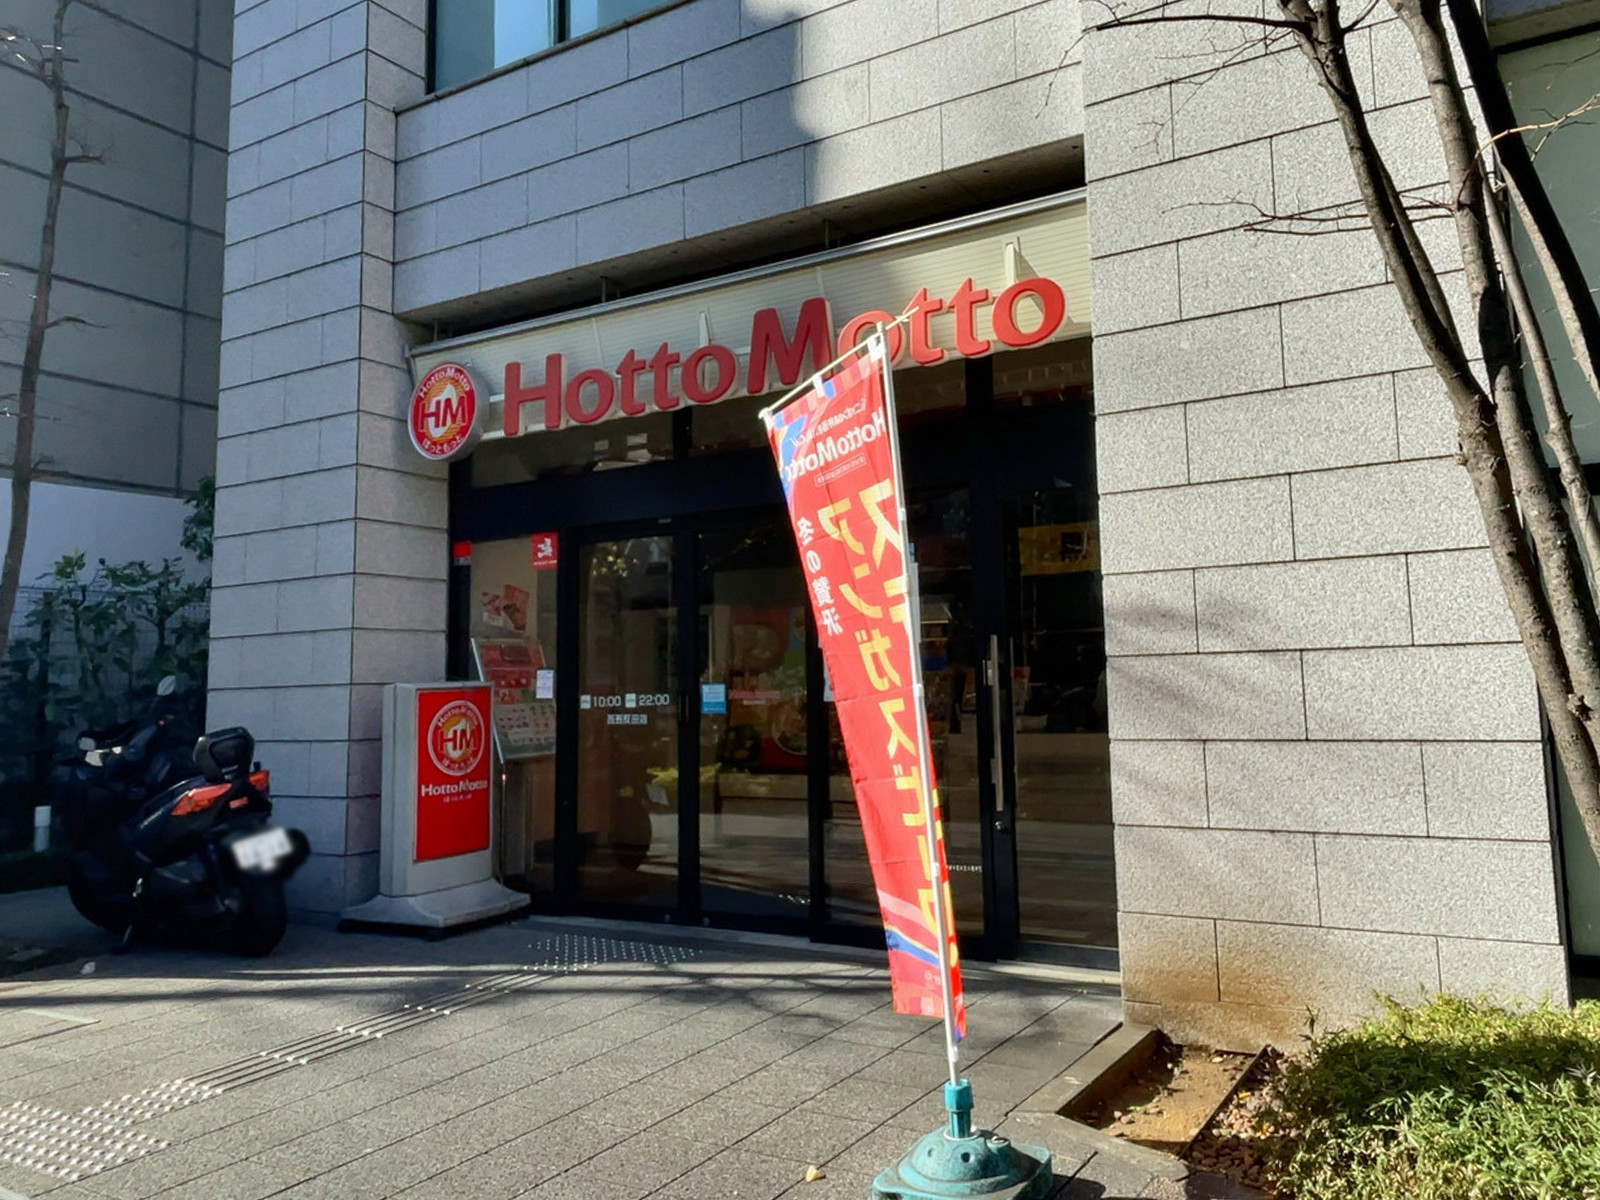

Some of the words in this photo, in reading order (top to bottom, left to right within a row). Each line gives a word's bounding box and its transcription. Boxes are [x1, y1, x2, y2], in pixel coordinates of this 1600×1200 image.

[417, 368, 470, 398] HottoMotto
[418, 393, 468, 432] HM
[593, 696, 622, 708] 10:00
[638, 694, 670, 706] 22:00
[438, 727, 479, 753] HM
